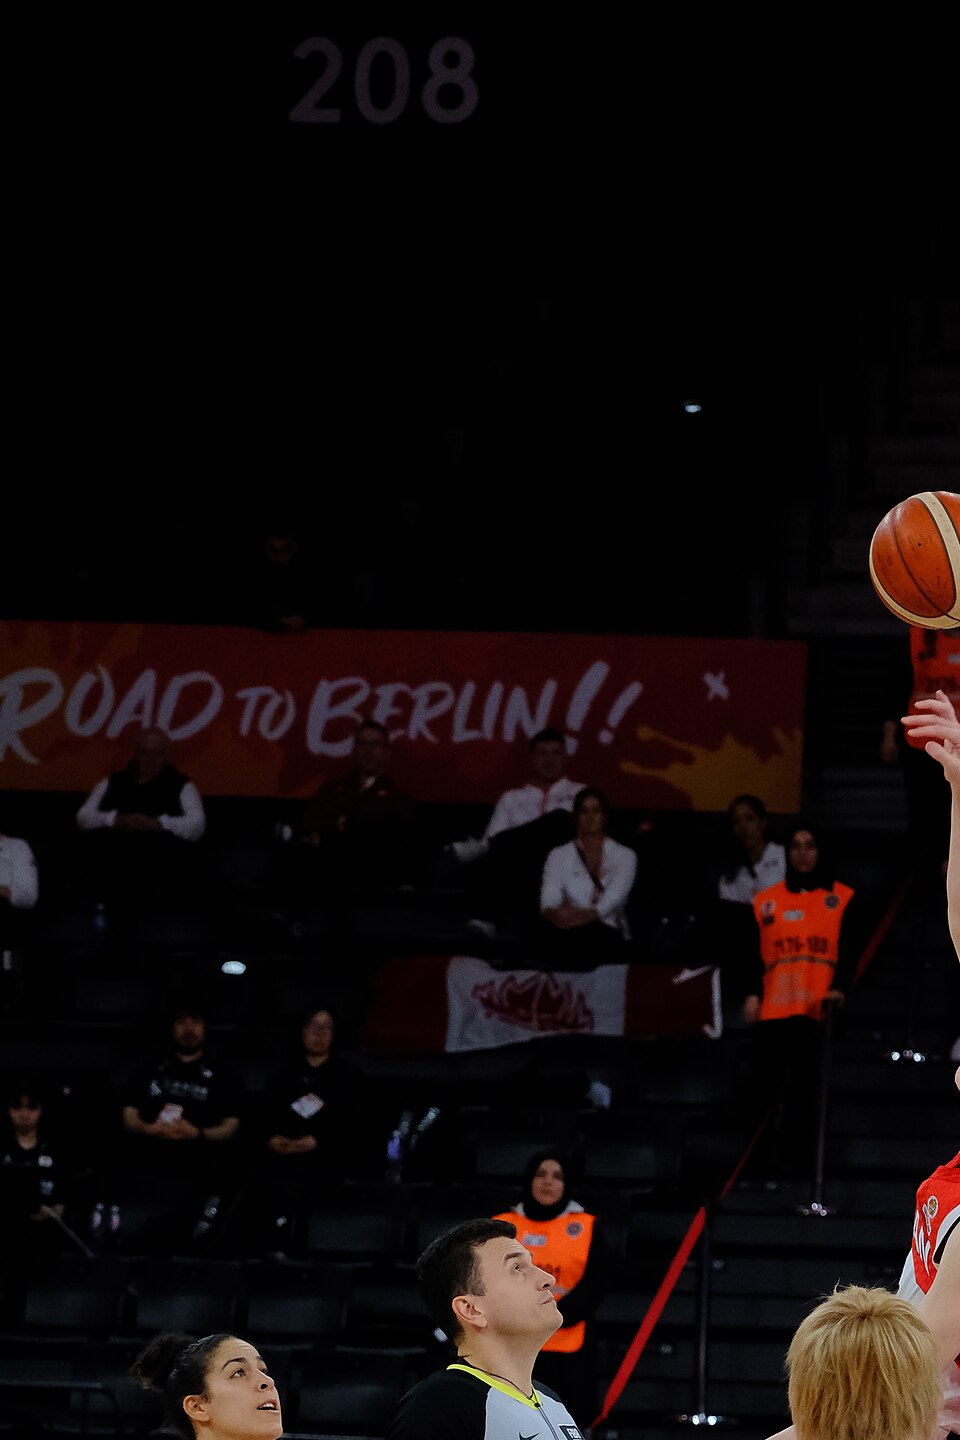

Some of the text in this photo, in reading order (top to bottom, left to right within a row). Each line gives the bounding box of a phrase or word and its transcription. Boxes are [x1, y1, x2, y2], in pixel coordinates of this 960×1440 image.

[289, 35, 480, 125] 208
[0, 666, 224, 765] ROAD
[236, 685, 296, 741] TO
